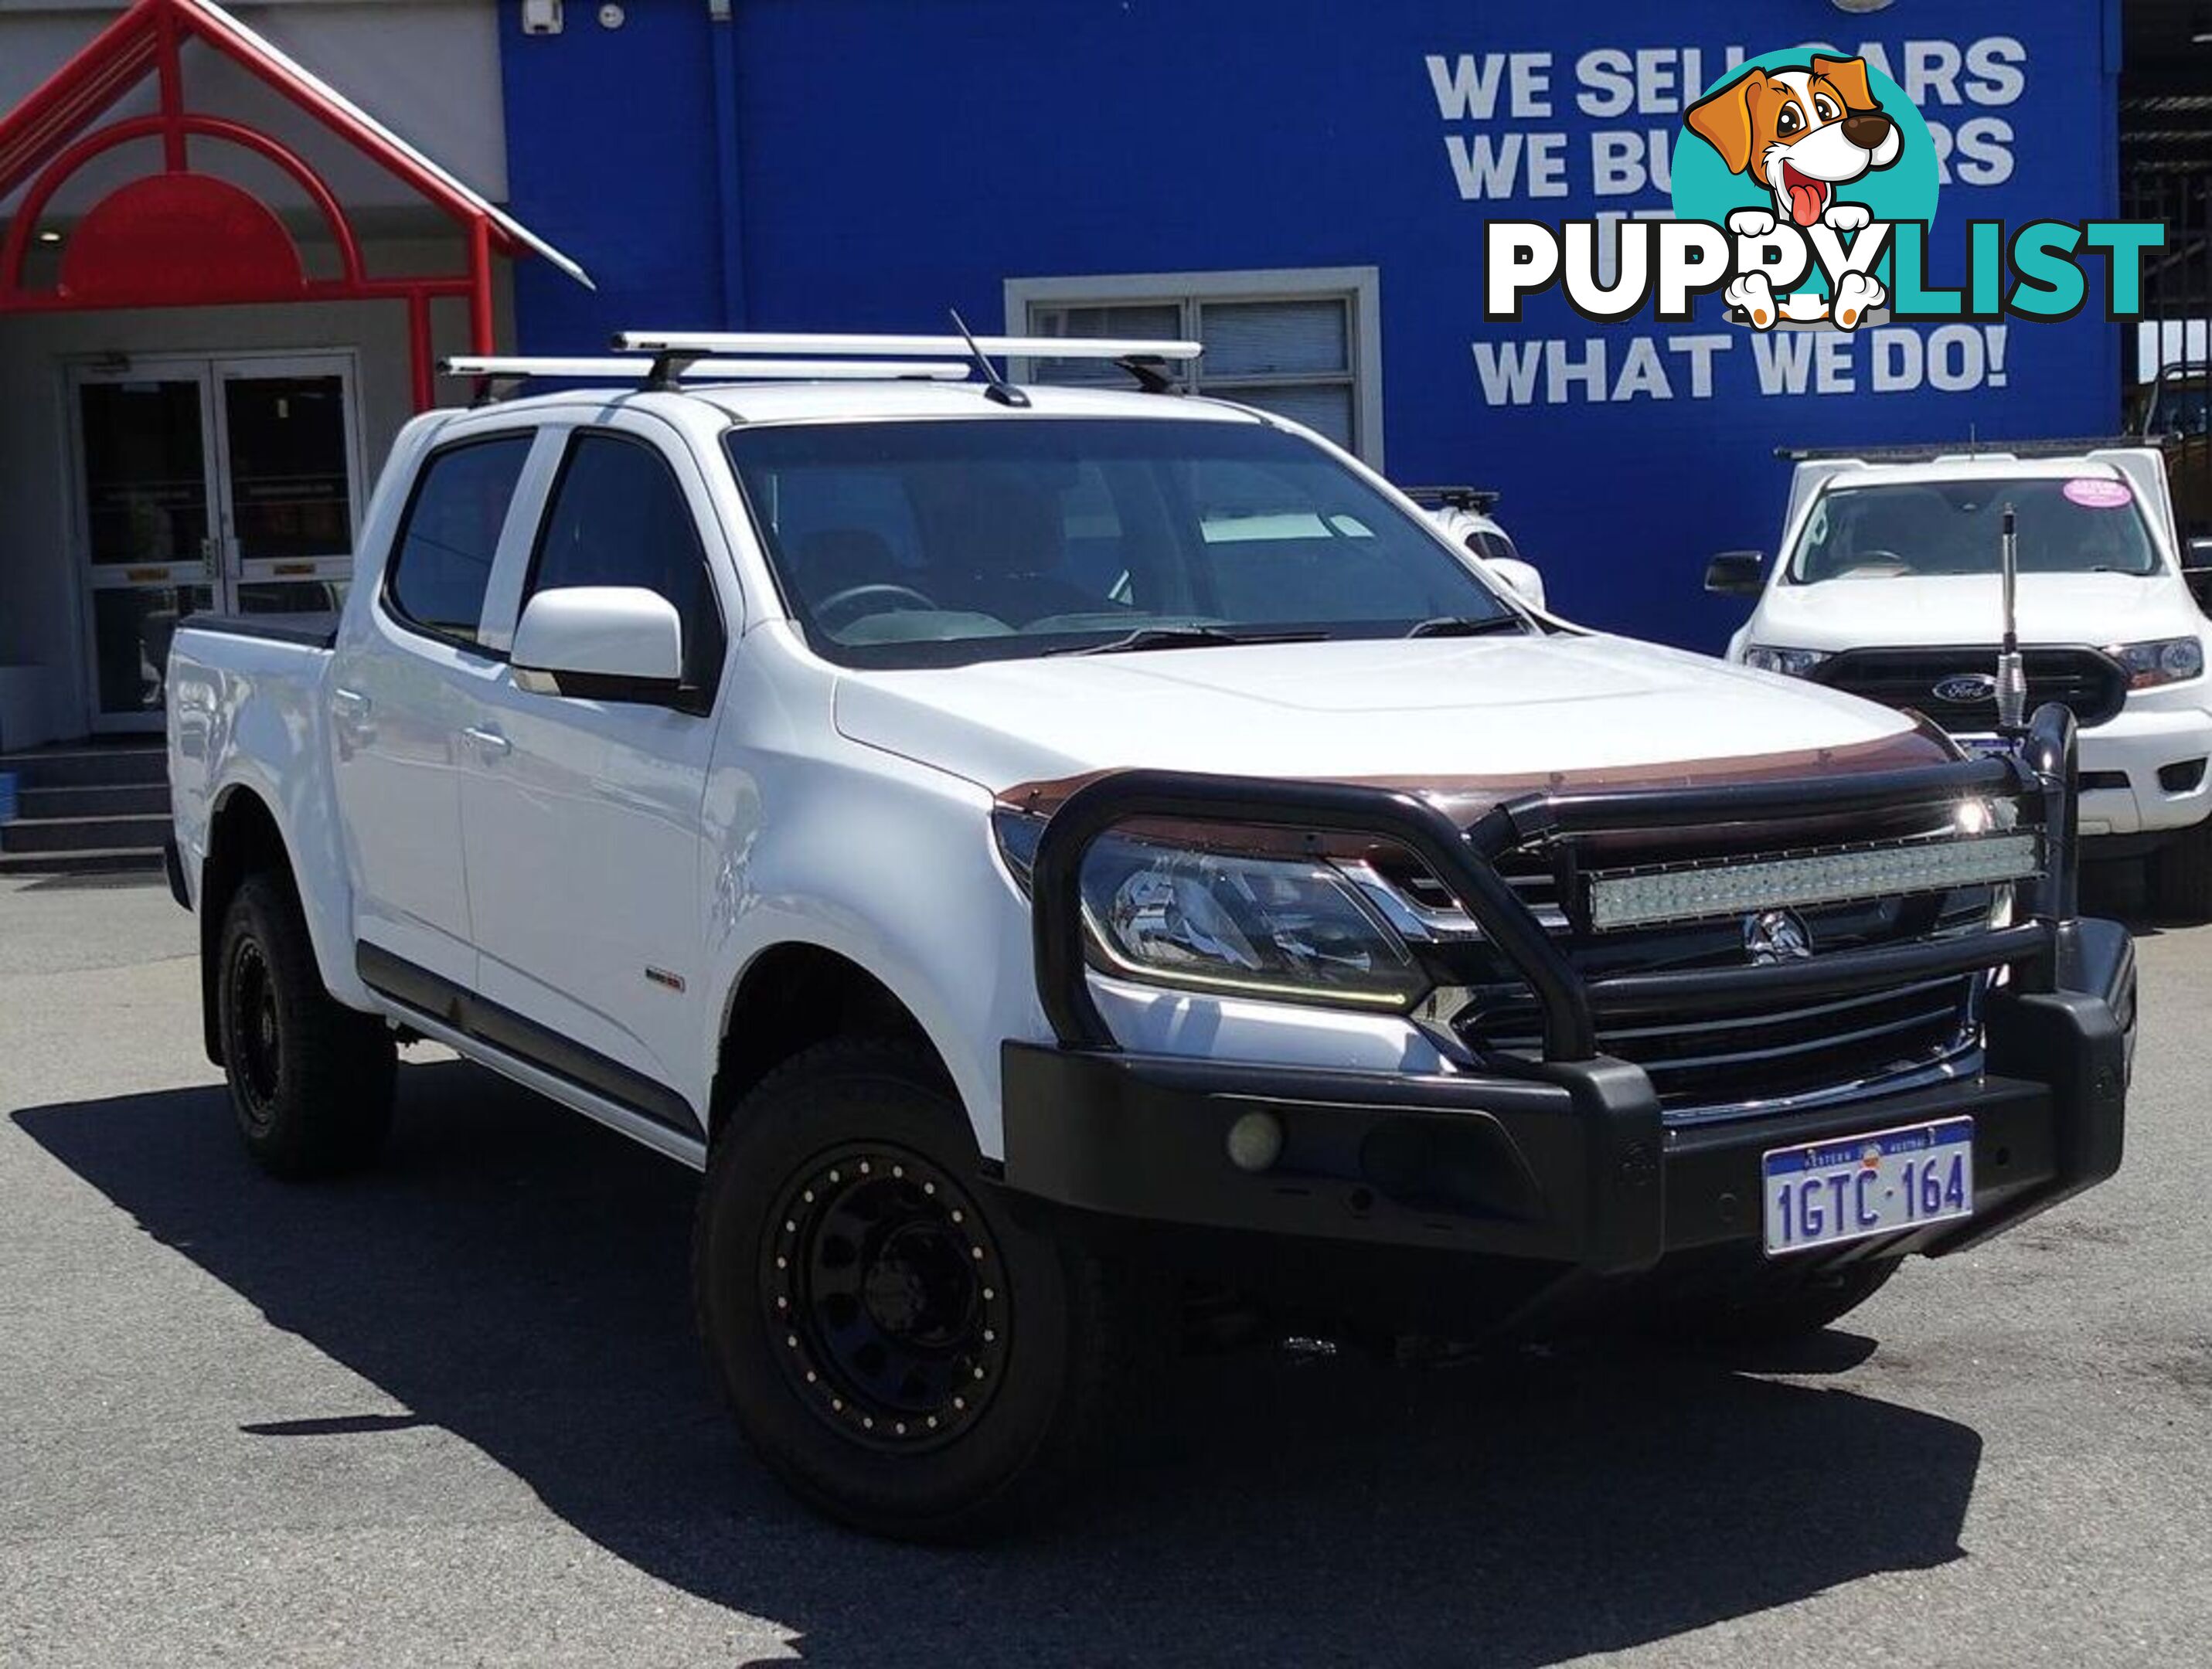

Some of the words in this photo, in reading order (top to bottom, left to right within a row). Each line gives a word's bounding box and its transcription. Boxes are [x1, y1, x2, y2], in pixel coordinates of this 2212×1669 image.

[1425, 53, 1552, 120] WE
[1444, 133, 1568, 199] WE
[1472, 335, 1733, 406] WHAT
[1751, 331, 1856, 396] WE
[1872, 324, 2008, 393] DO!
